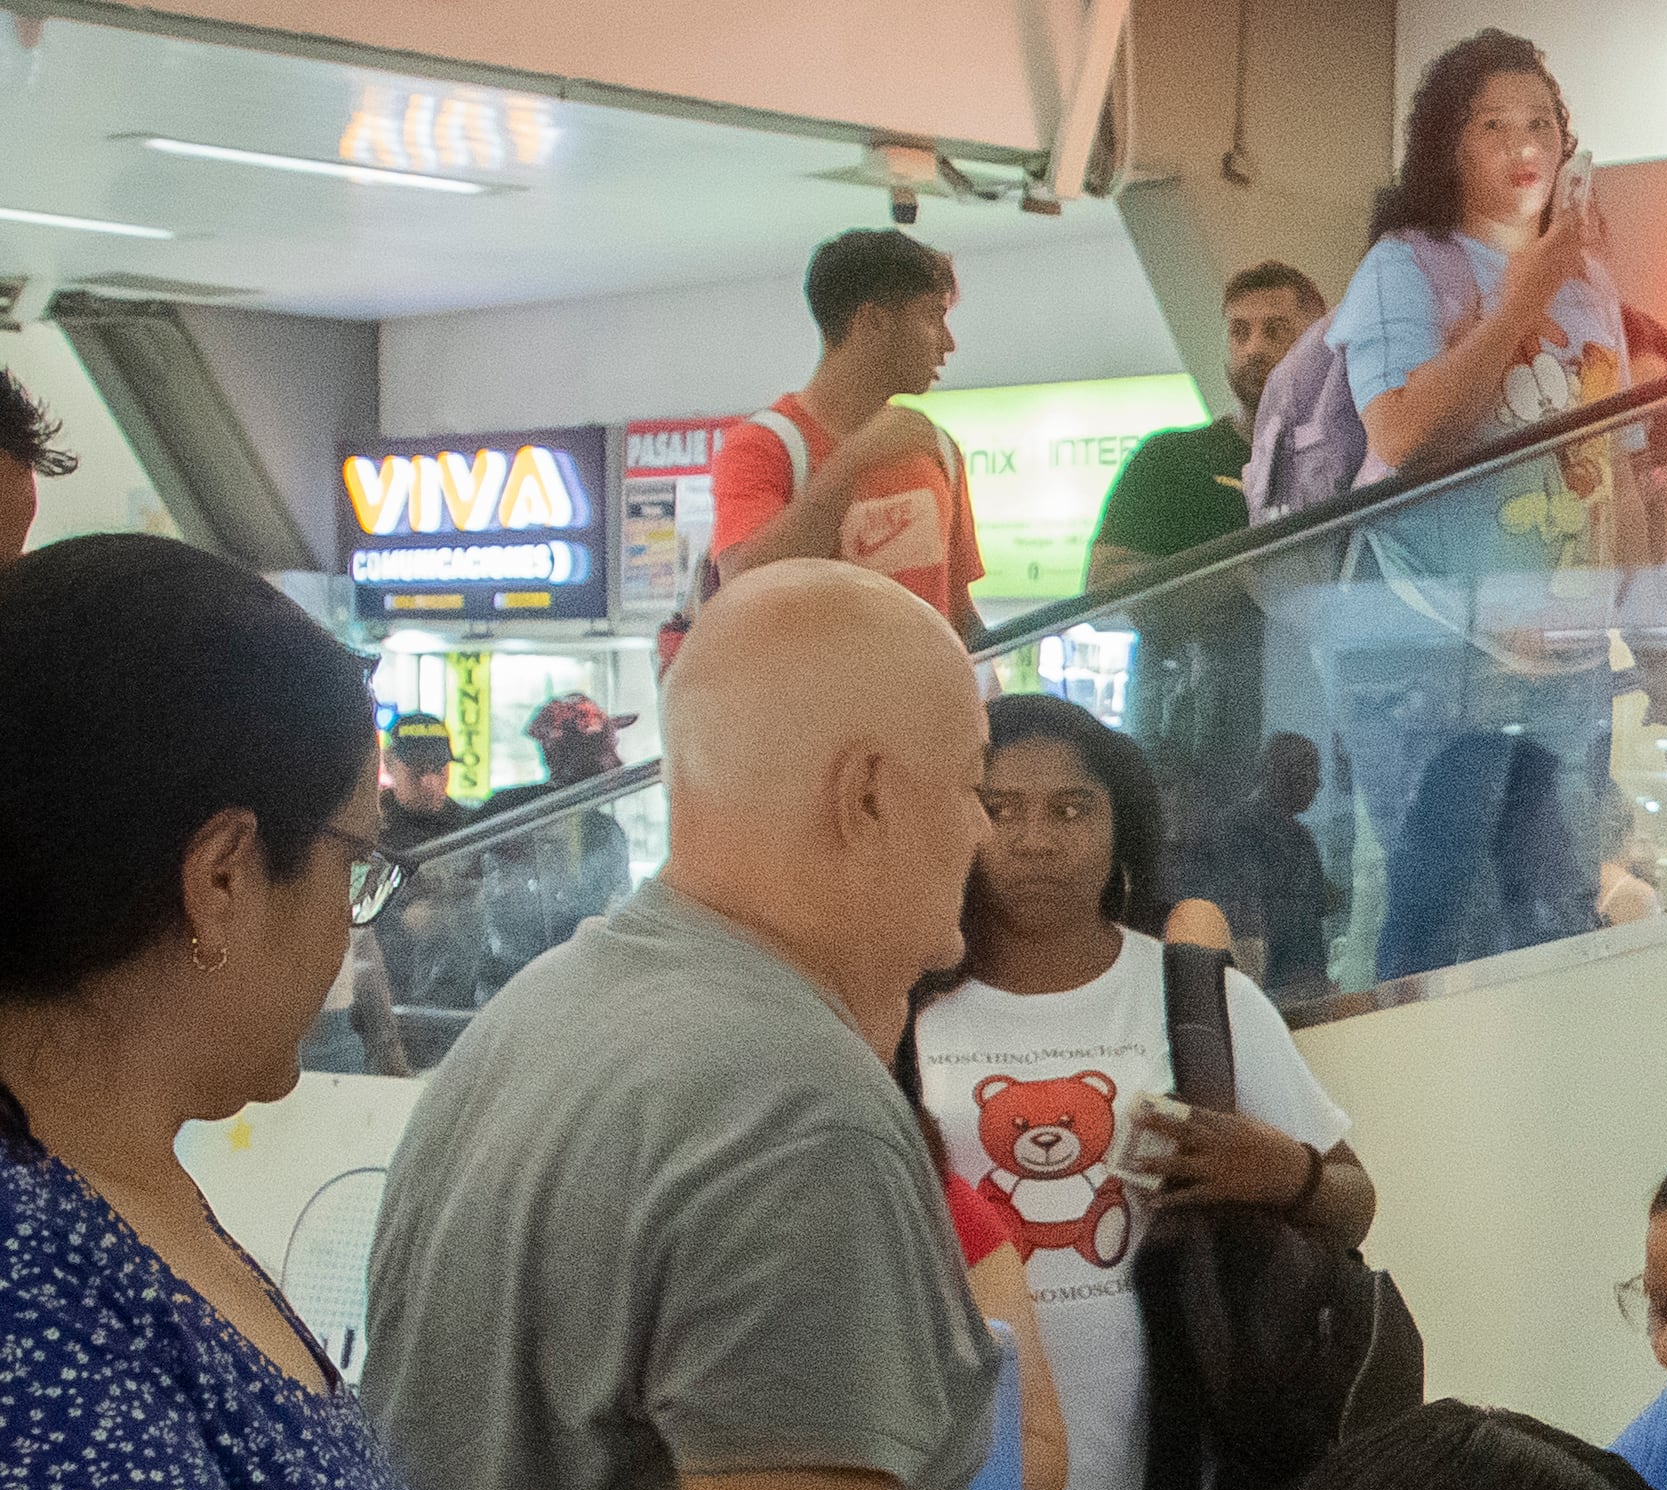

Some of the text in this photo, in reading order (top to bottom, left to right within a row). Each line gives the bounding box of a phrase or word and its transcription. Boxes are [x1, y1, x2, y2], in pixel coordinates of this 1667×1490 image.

[343, 445, 580, 535] VIVA
[626, 430, 707, 468] PASAJE
[455, 651, 482, 789] MINUTOS
